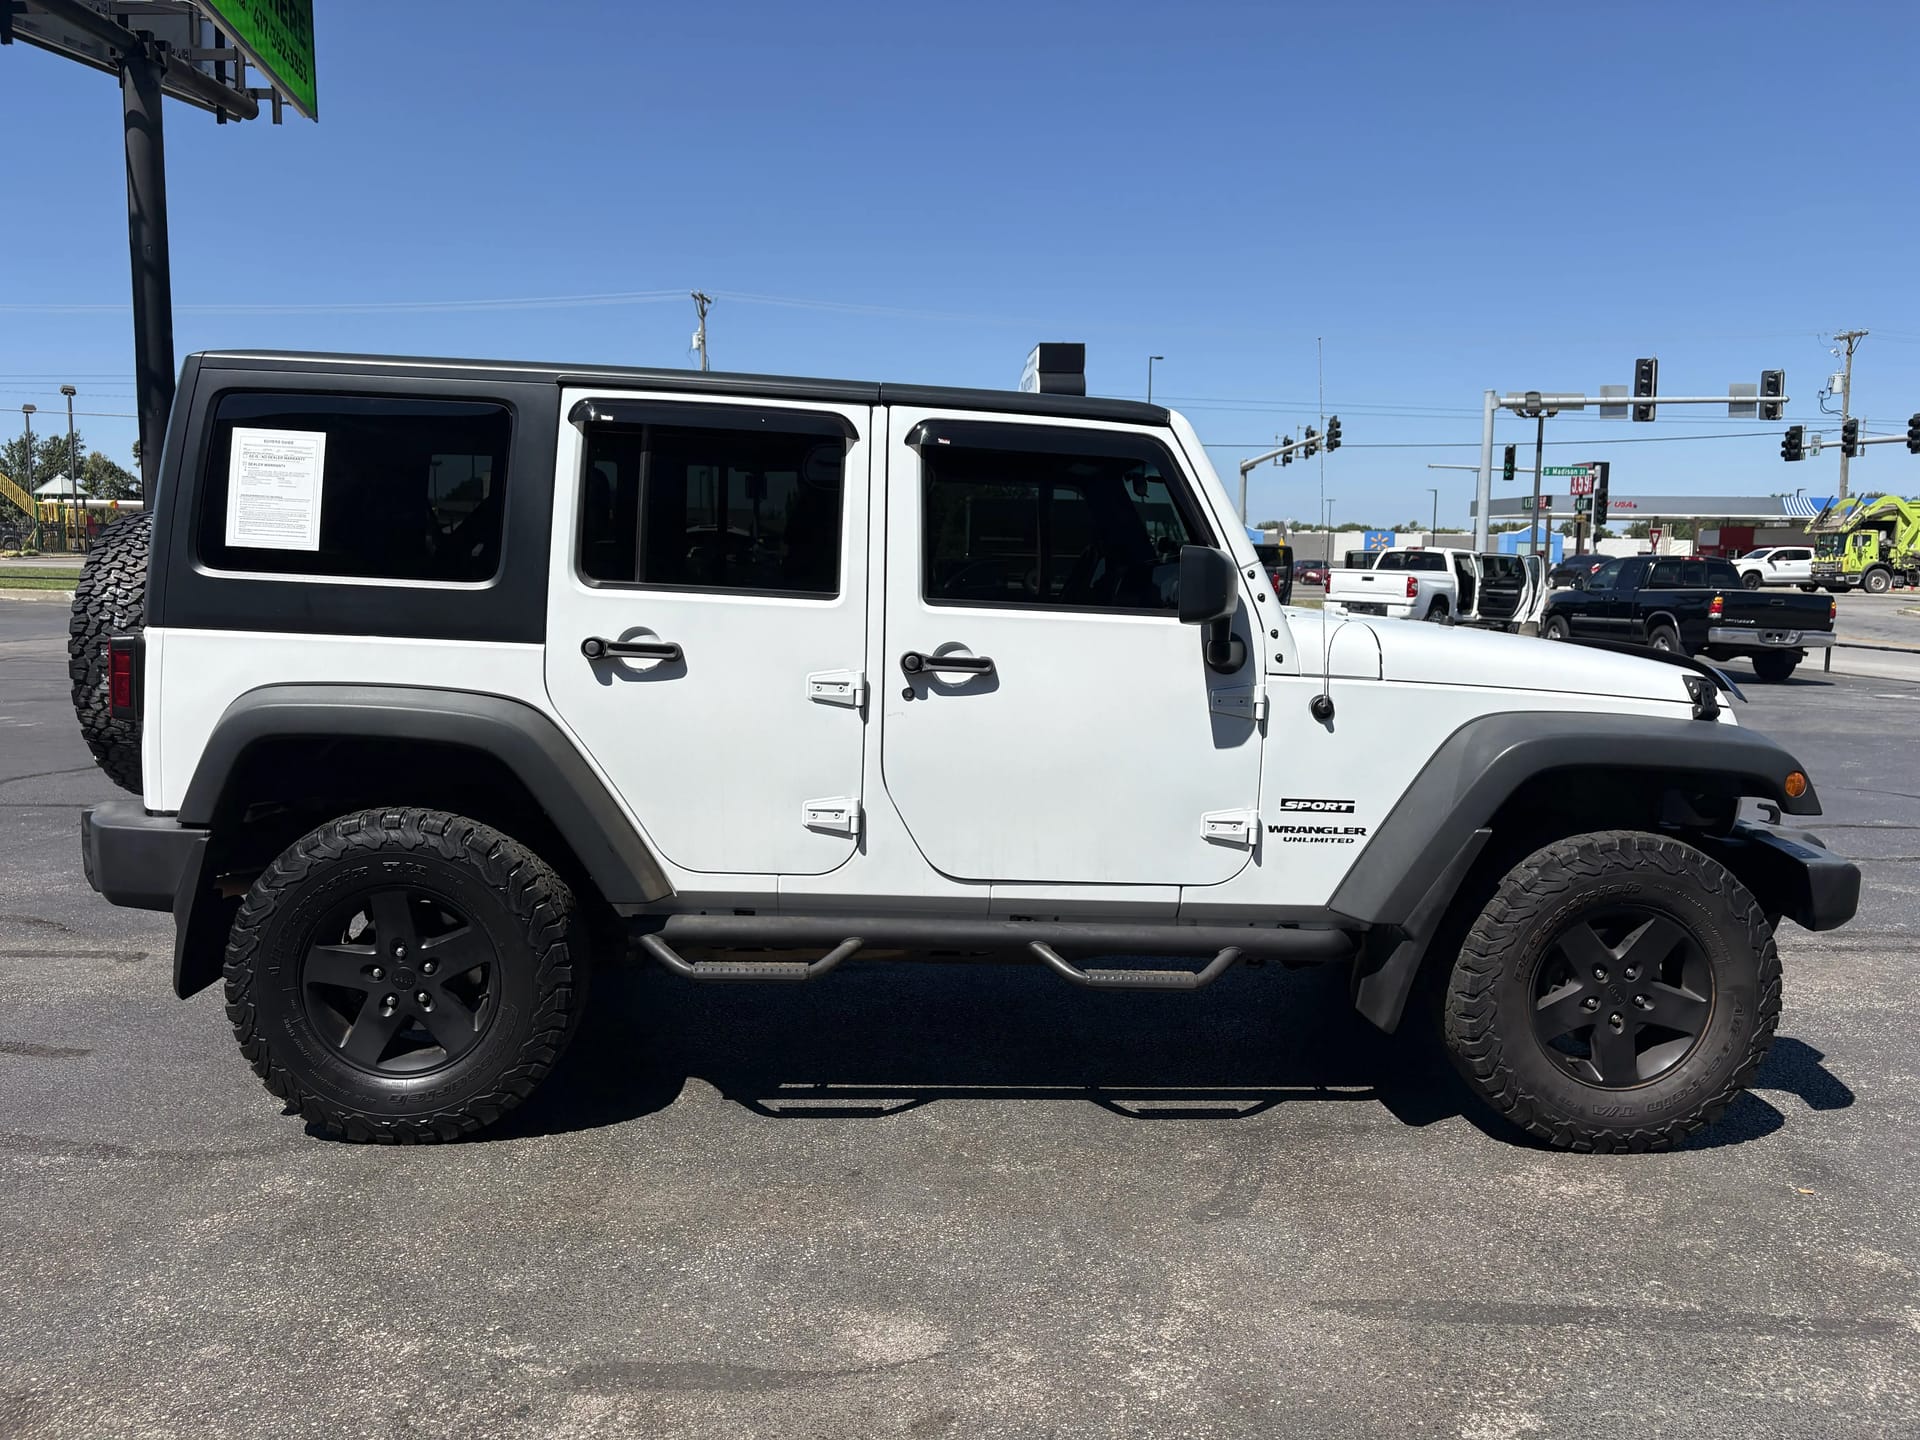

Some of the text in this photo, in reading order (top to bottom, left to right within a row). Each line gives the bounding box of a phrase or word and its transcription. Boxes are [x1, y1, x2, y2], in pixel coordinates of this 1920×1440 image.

[1552, 467, 1578, 475] Madison
[1285, 801, 1348, 811] SPORT
[1268, 825, 1367, 836] WRANGLER
